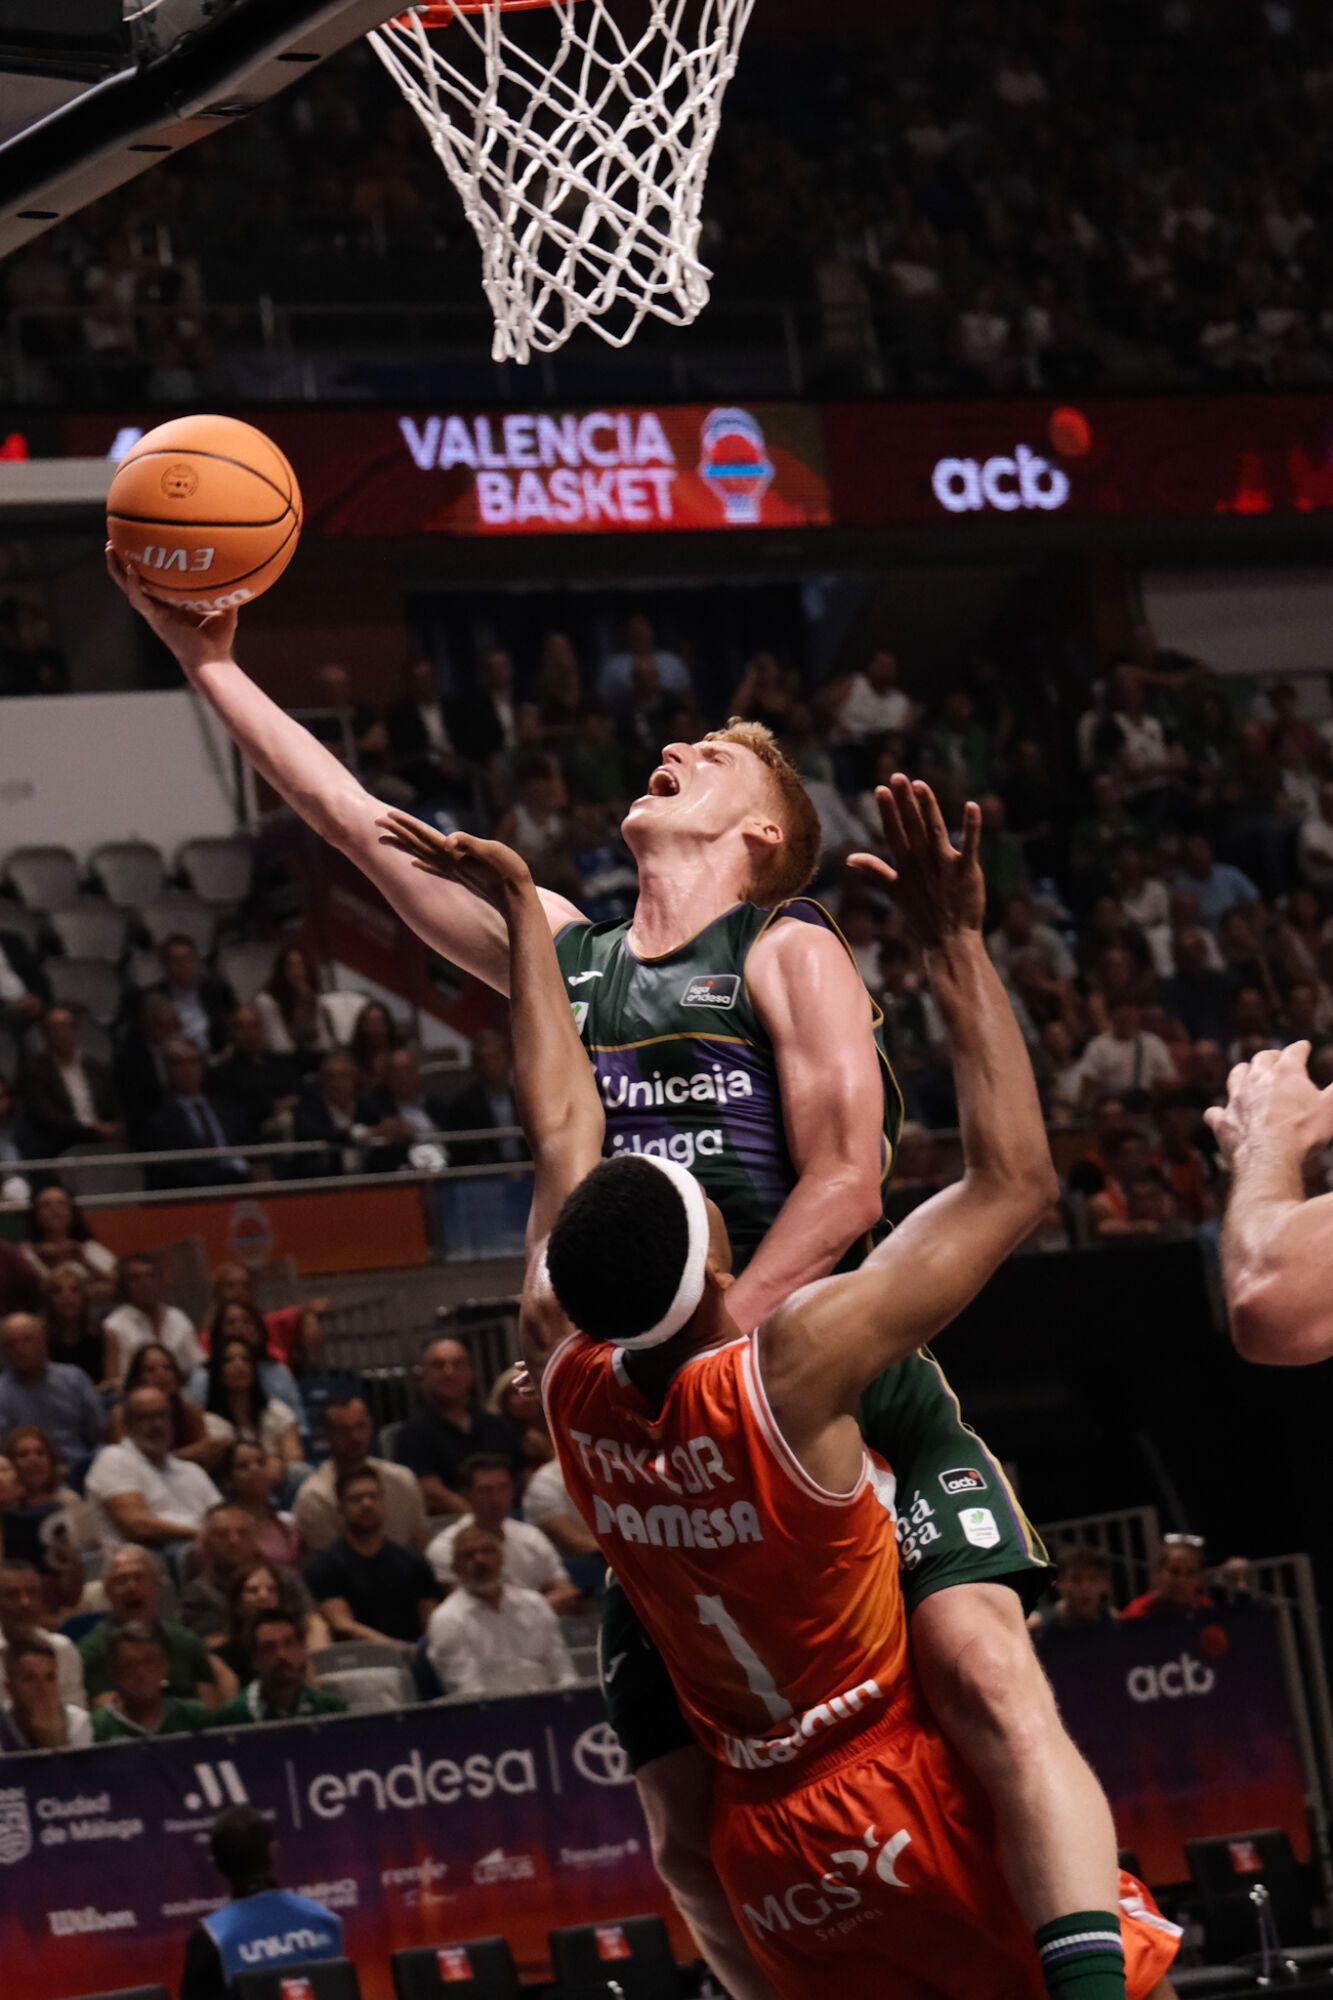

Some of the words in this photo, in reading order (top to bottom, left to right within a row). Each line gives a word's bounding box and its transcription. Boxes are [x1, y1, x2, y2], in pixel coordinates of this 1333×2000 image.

[398, 411, 676, 471] VALENCIA
[476, 466, 678, 525] BASKET
[931, 443, 1071, 513] acb
[601, 1063, 753, 1108] Unicaja
[612, 1128, 725, 1169] laga
[569, 1428, 736, 1495] TAYLOR
[948, 1476, 978, 1490] acb
[592, 1494, 764, 1550] PAMESA
[694, 1594, 795, 1722] 1
[1126, 1651, 1216, 1703] acb
[308, 1748, 538, 1820] endesa
[742, 1871, 863, 1941] MGS
